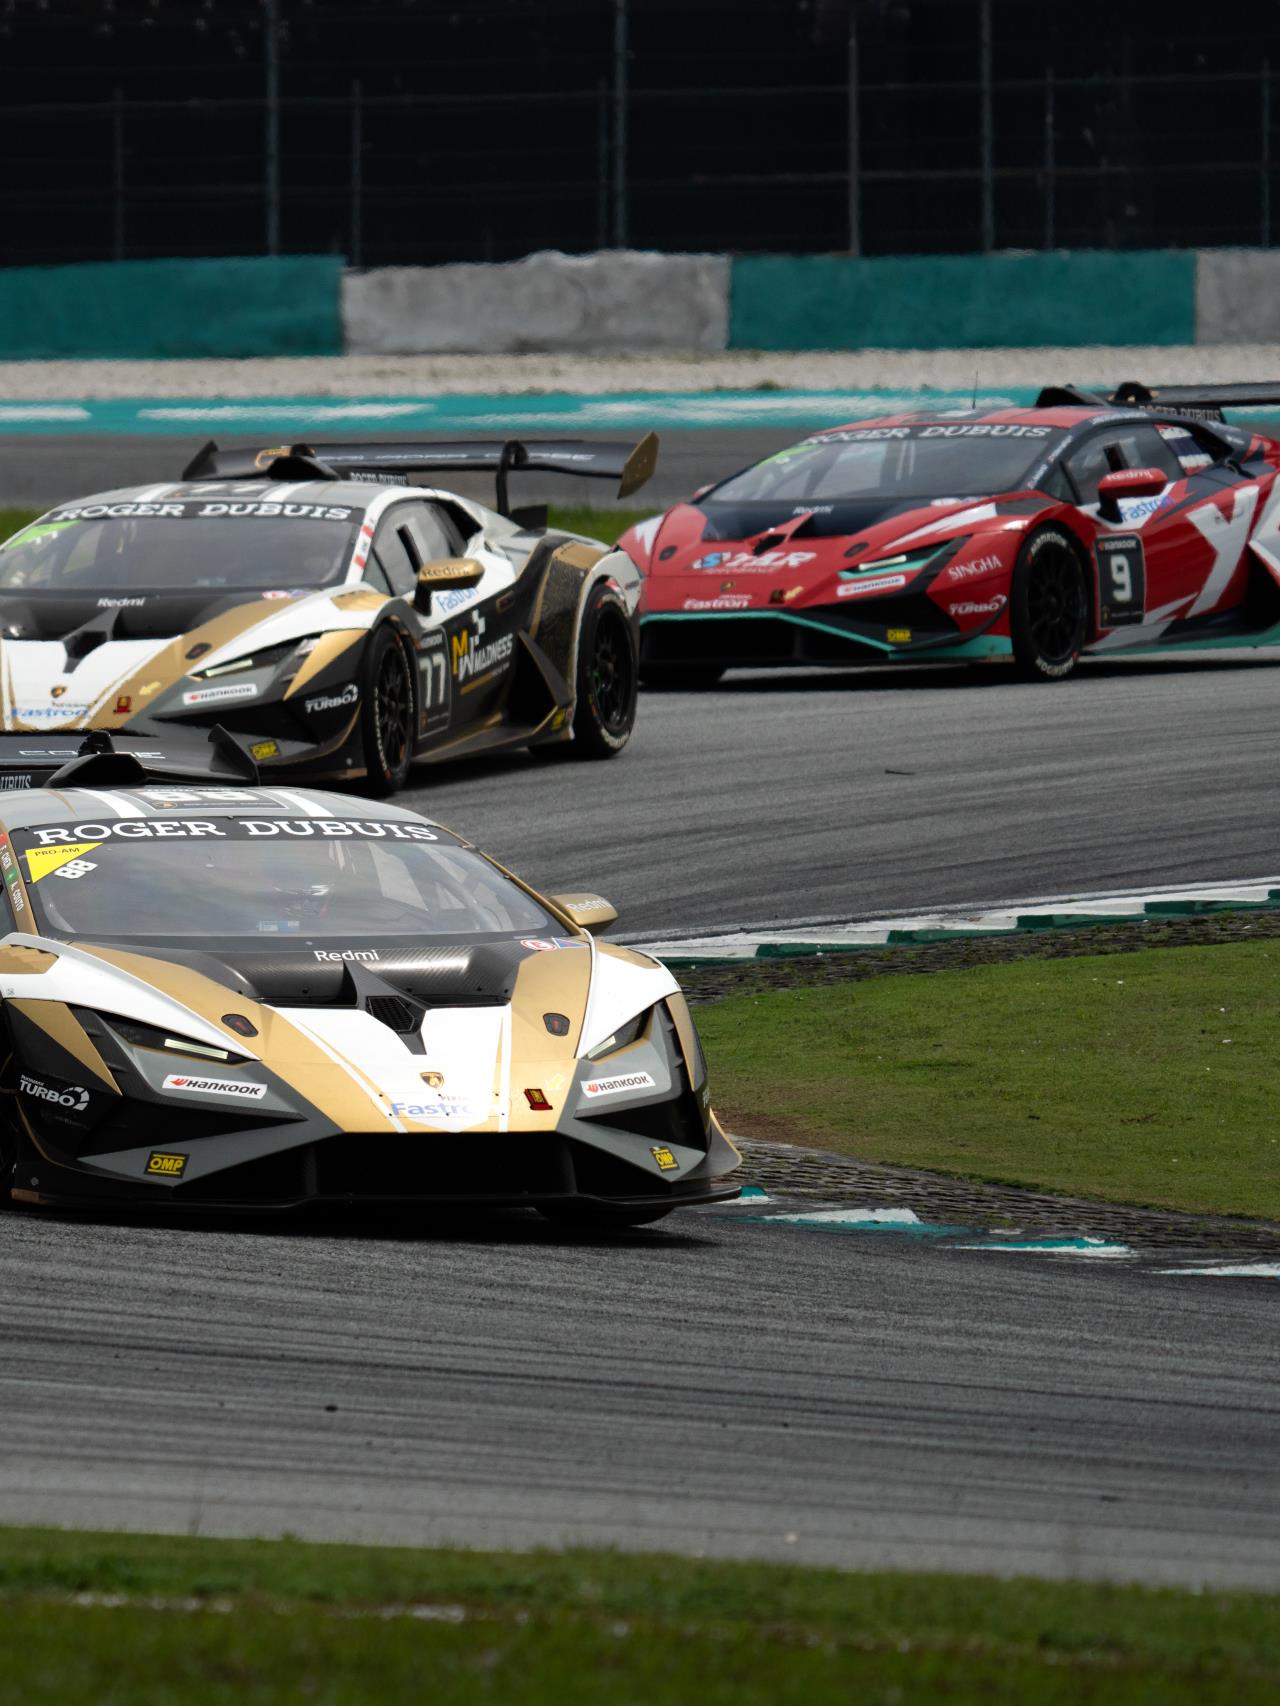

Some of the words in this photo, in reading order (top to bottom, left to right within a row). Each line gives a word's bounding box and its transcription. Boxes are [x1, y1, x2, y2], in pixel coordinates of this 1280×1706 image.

[799, 427, 911, 445] ROGER
[919, 425, 1052, 438] DUBUIS
[53, 503, 183, 521] ROGER
[198, 503, 352, 520] DUBUIS
[948, 555, 1003, 579] SINGHA
[1109, 554, 1132, 602] 9
[96, 597, 145, 607] Redmi
[420, 652, 445, 709] 77
[306, 696, 348, 713] TURBO
[33, 821, 226, 845] ROGER
[238, 820, 439, 841] DUBUIS
[34, 847, 80, 857] PRO-AM
[54, 859, 98, 879] 88
[313, 949, 380, 962] Redmi
[20, 1080, 76, 1106] TURBO
[150, 1157, 184, 1172] OMP
[655, 1152, 674, 1167] OMP
